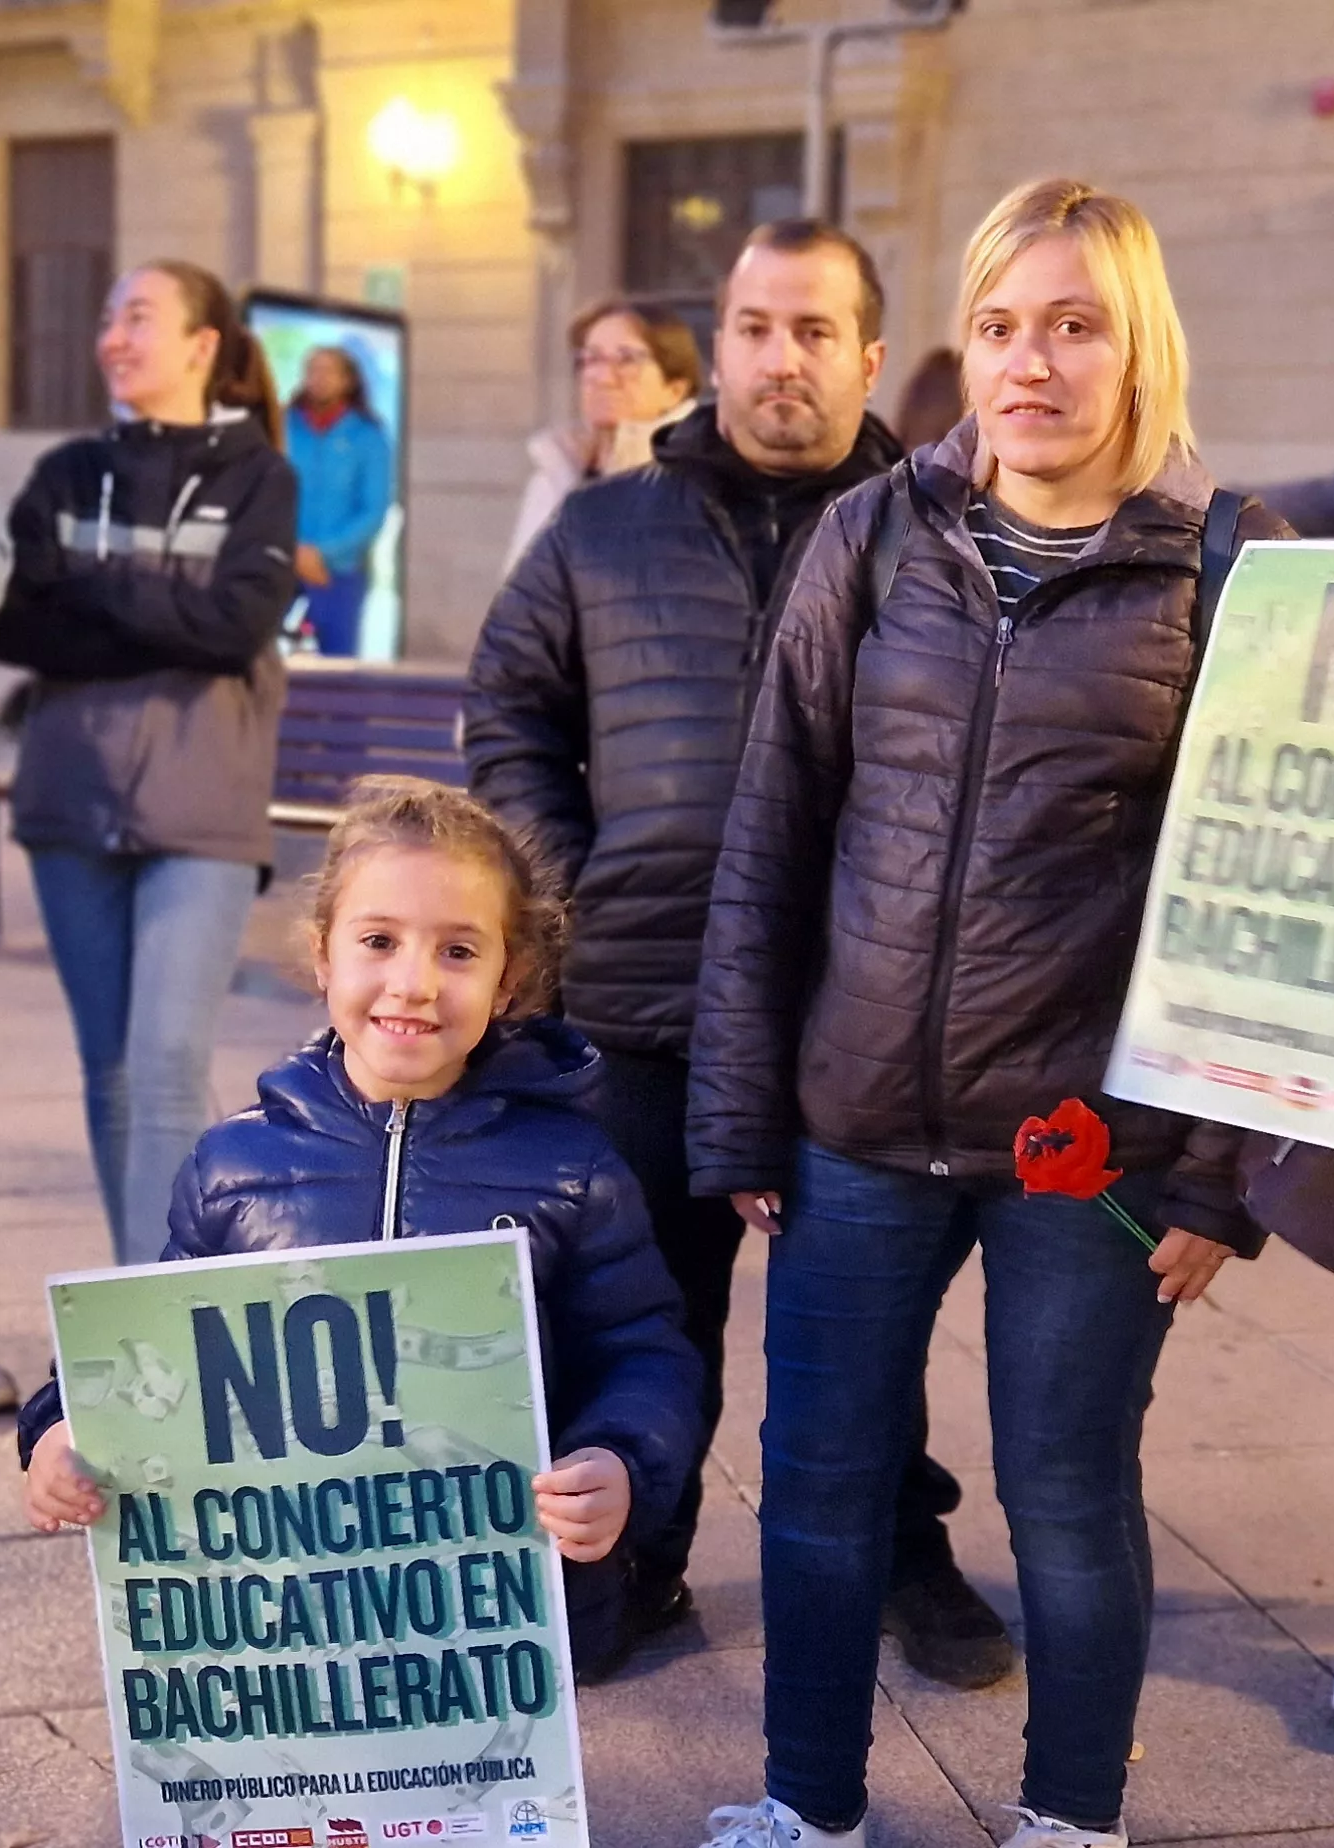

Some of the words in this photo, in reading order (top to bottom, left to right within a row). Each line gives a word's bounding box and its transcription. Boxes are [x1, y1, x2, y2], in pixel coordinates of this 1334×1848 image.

[1203, 735, 1251, 806] AL
[191, 1290, 405, 1464] NO!
[117, 1490, 187, 1564] AL
[194, 1461, 527, 1562] CONCIERTO
[124, 1557, 447, 1652] EDUCATIVO
[458, 1547, 540, 1630] EN
[122, 1639, 549, 1742] BACHILLERATO
[161, 1779, 222, 1803] DINERO
[224, 1773, 296, 1799] PÚBLICO
[298, 1774, 342, 1797] PARA
[344, 1772, 365, 1793] LA
[367, 1760, 463, 1793] EDUCACIÓN
[465, 1757, 536, 1784] PÚBLICA
[235, 1833, 289, 1846] CCOO
[383, 1821, 421, 1838] UGT
